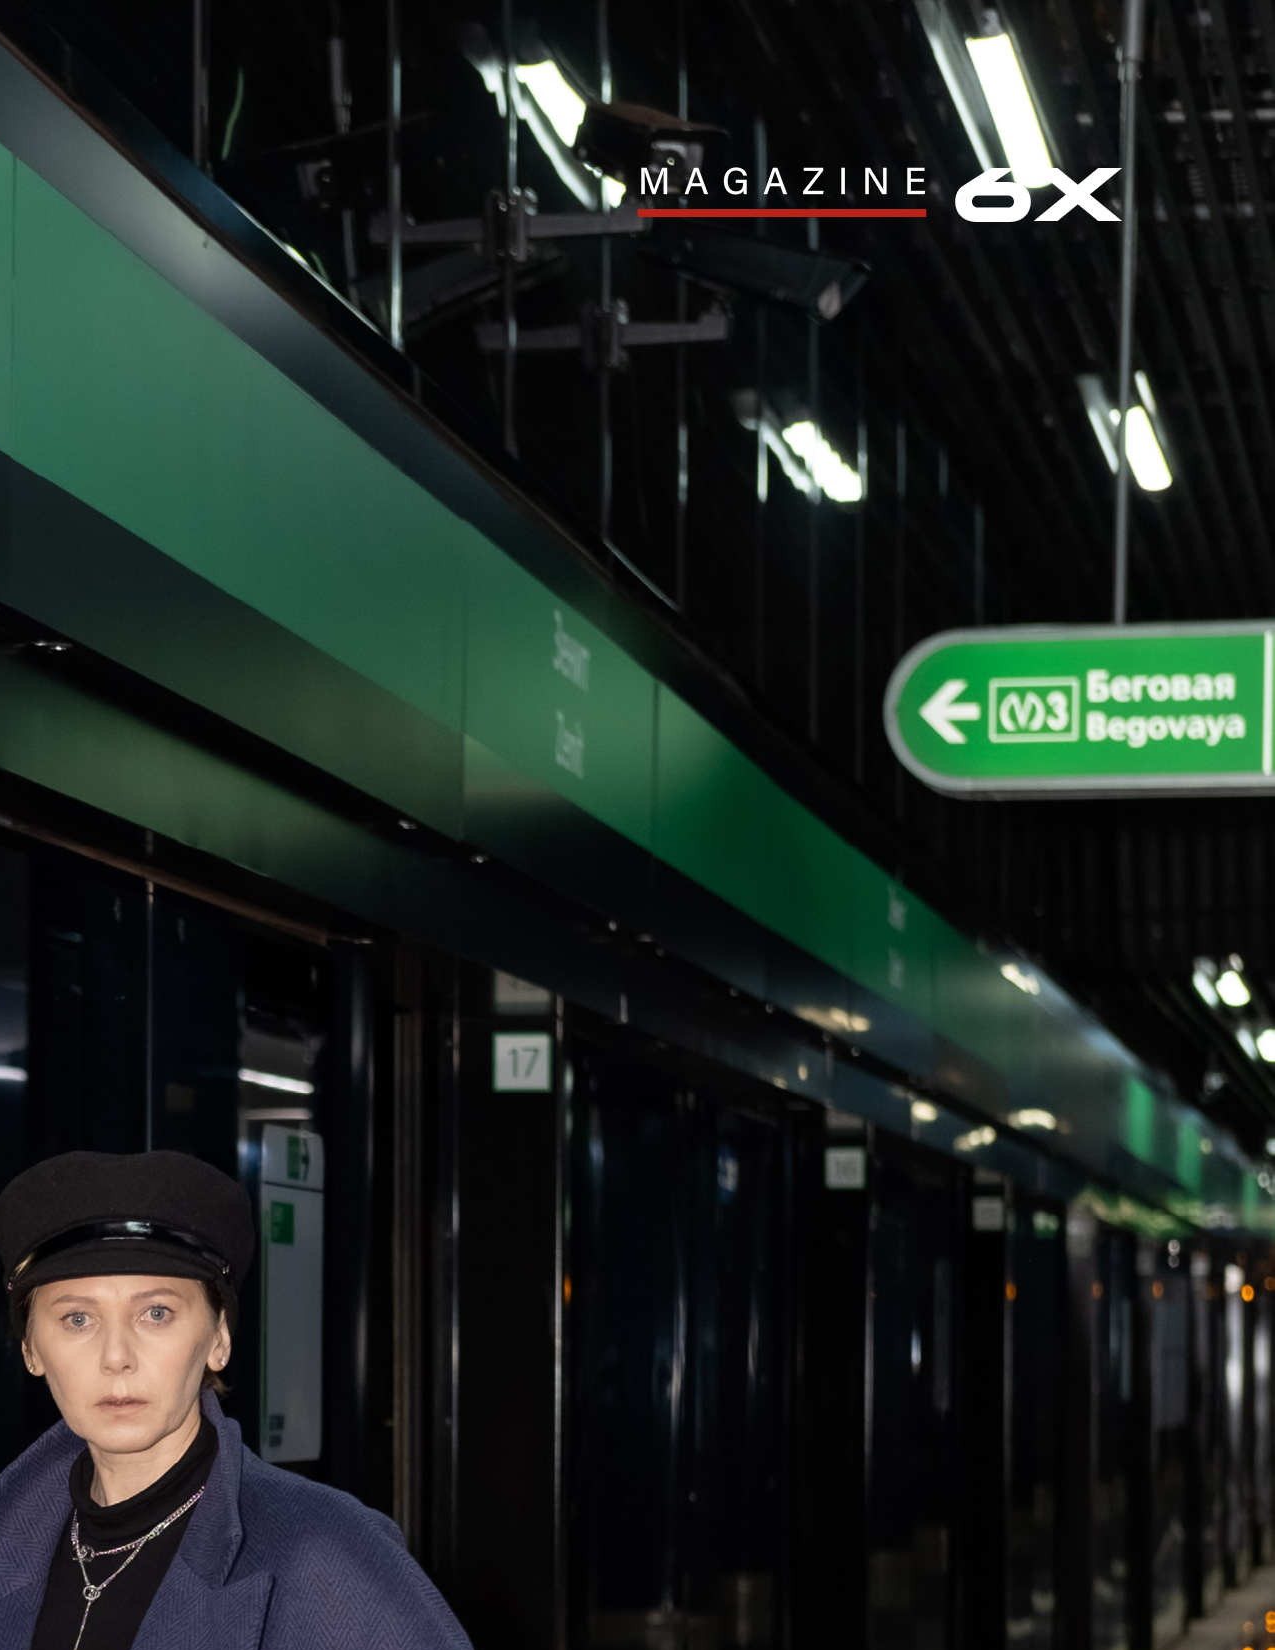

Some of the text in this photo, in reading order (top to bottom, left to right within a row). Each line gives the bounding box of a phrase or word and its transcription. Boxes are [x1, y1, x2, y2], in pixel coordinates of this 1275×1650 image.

[1085, 668, 1237, 704] Беговая
[1085, 708, 1247, 749] Begovaya
[507, 1047, 540, 1079] 17
